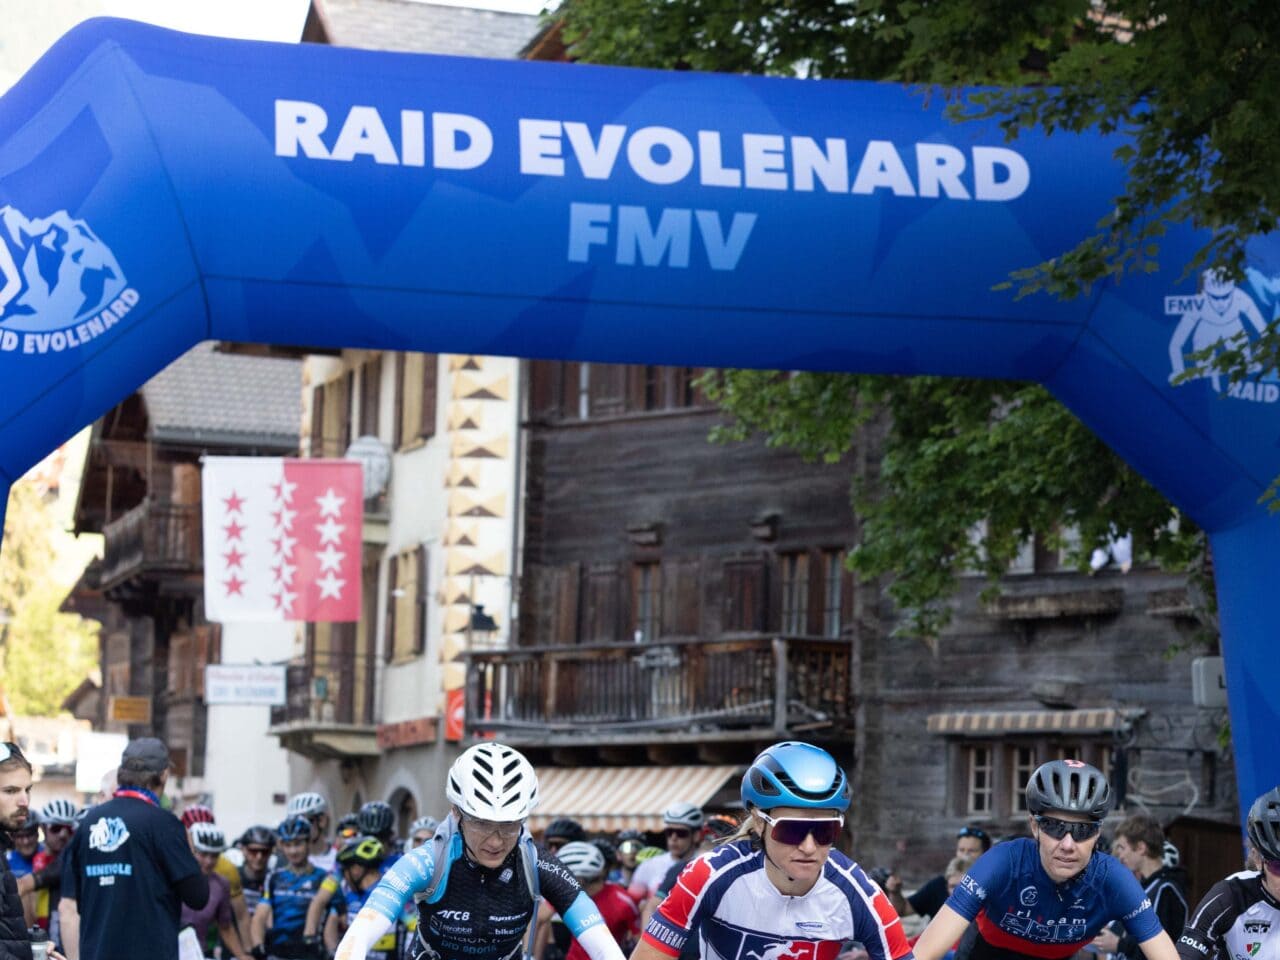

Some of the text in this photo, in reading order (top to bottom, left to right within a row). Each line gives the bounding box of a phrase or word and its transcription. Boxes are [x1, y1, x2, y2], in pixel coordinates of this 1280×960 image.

[275, 100, 1031, 203] RAID EVOLENARD
[567, 203, 757, 271] FMV
[23, 288, 140, 354] EVOLENARD
